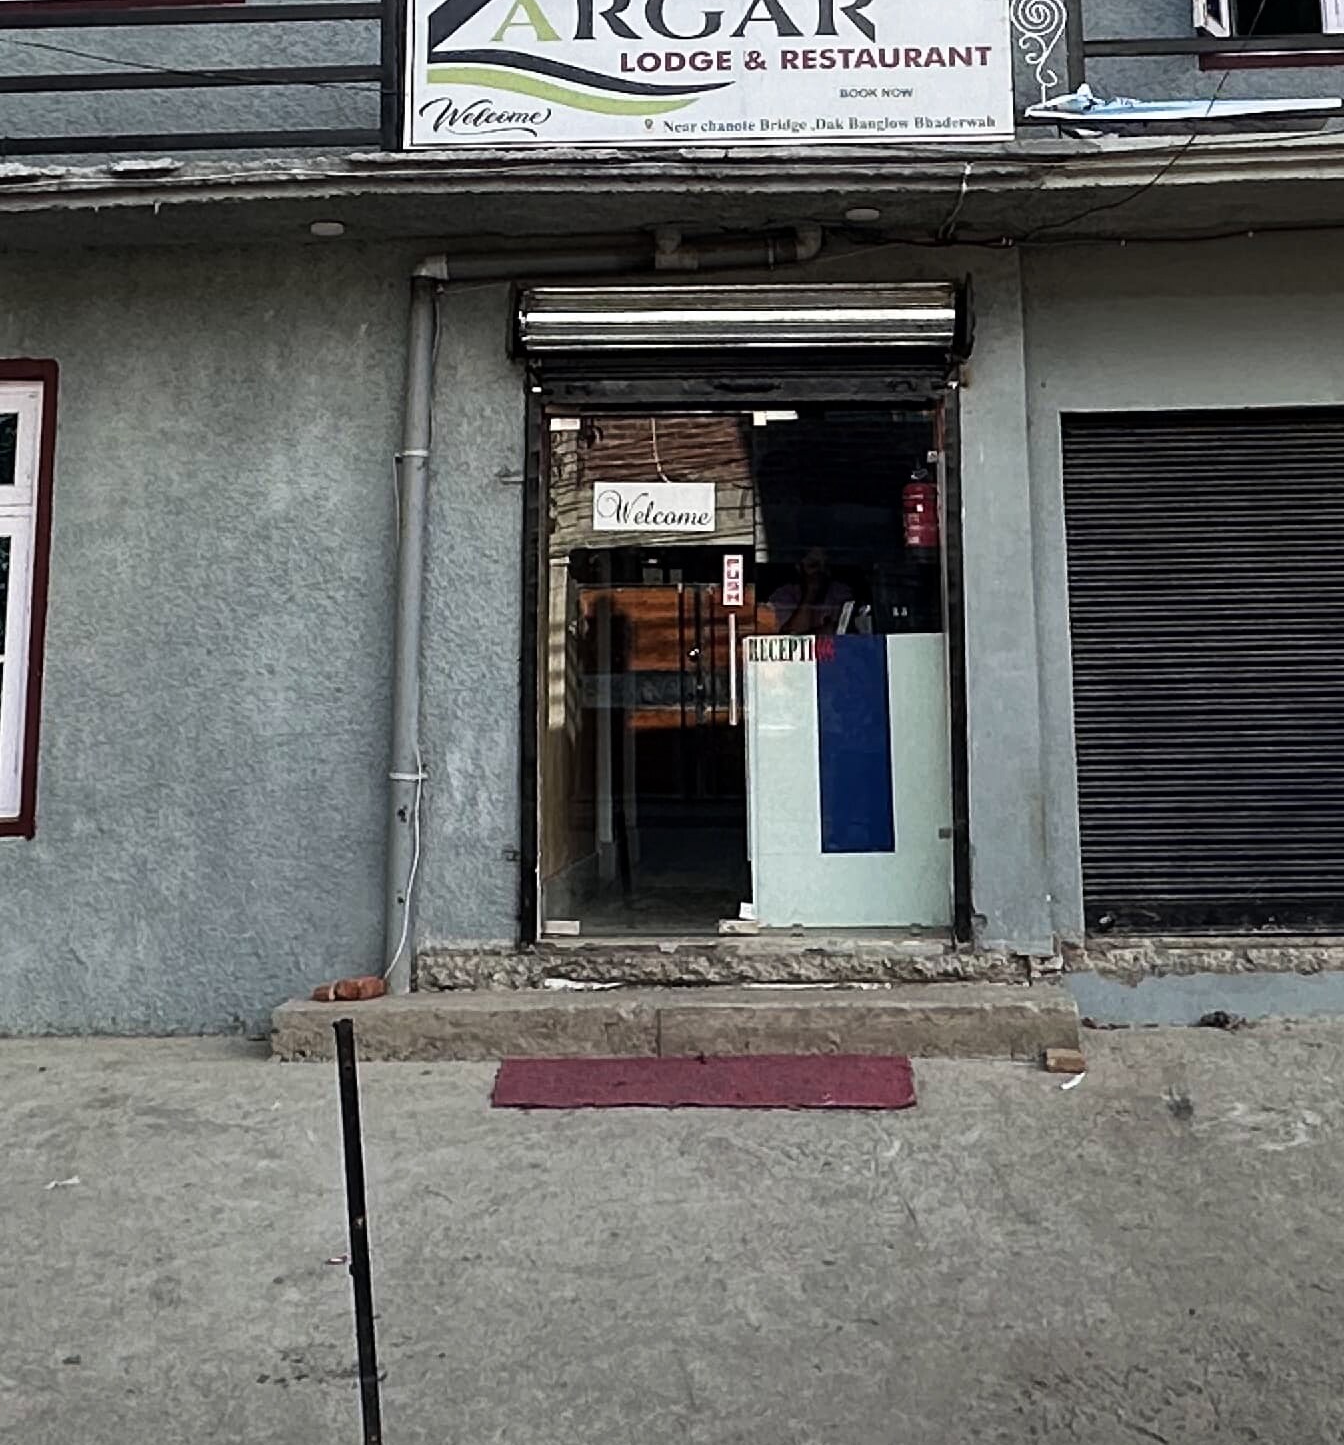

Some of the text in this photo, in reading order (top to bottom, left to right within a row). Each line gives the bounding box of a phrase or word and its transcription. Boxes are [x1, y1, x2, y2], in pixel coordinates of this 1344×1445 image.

[620, 46, 992, 73] LODGE & RESTAURANT
[840, 88, 914, 98] BOOK NOW
[418, 97, 552, 137] Welcome
[663, 120, 696, 133] Near
[760, 118, 808, 134] Bridge
[596, 489, 712, 526] Welcome
